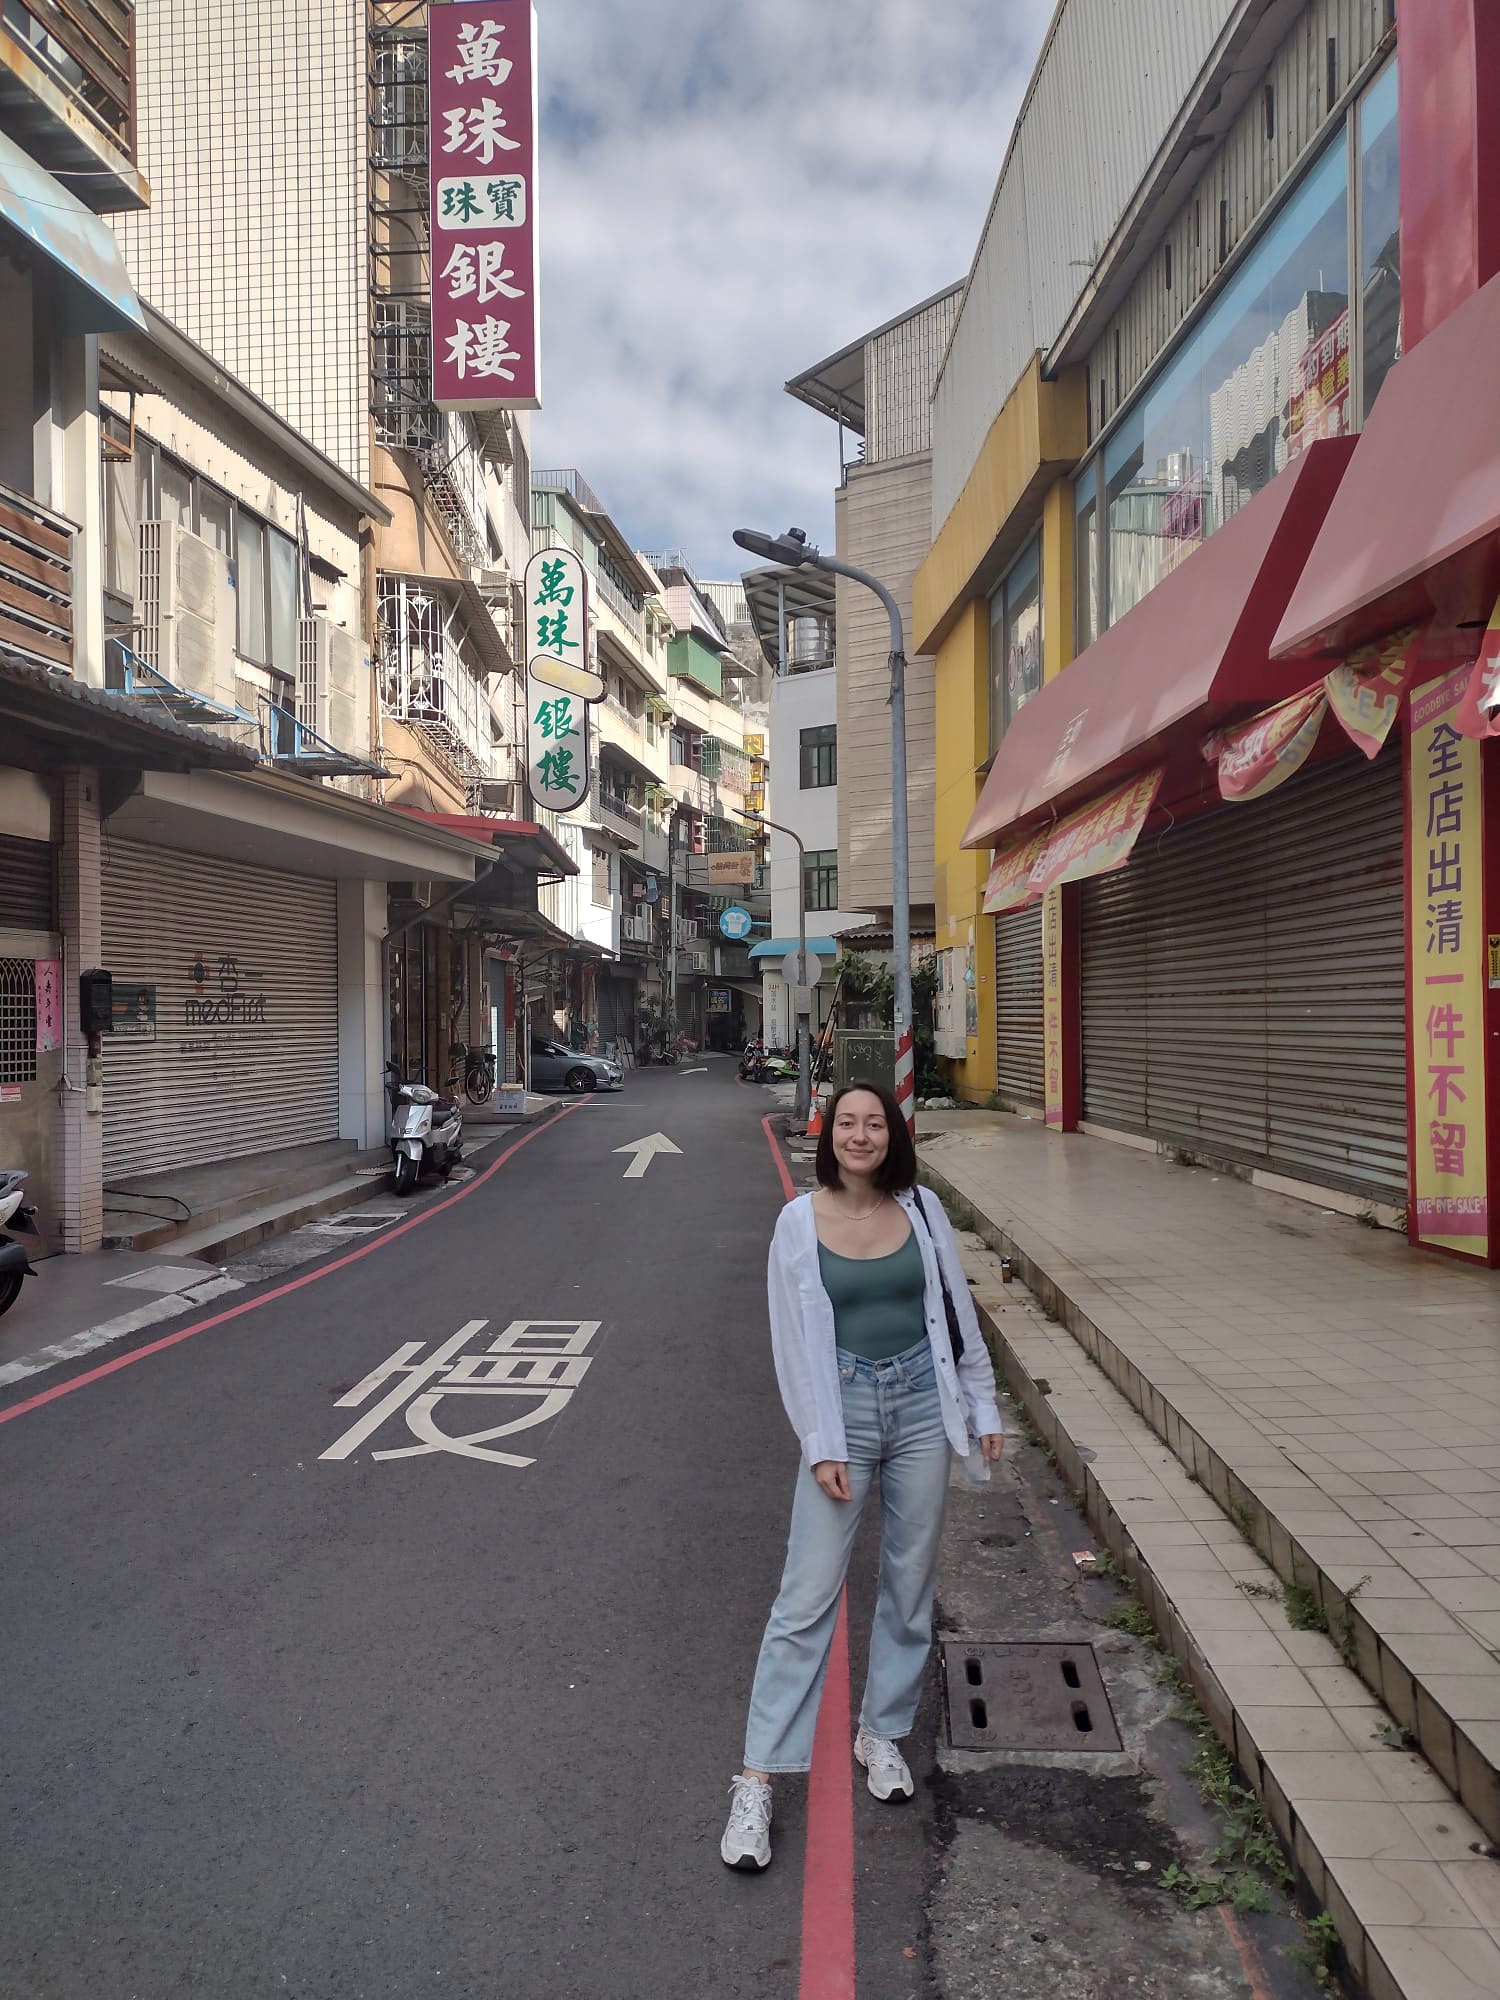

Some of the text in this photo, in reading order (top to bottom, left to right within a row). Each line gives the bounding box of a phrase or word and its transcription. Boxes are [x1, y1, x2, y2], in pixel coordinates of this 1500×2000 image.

[440, 19, 522, 165] 萬珠
[441, 179, 522, 224] 珠寶
[439, 240, 526, 382] 銀樓
[533, 557, 580, 656] 萬珠
[1454, 677, 1469, 697] SAL
[534, 697, 580, 795] 銀樓
[1425, 722, 1466, 1178] 全店出清一件不留
[1417, 1199, 1432, 1214] BYE
[1457, 1197, 1481, 1214] SALE
[317, 1319, 602, 1468] 慢
